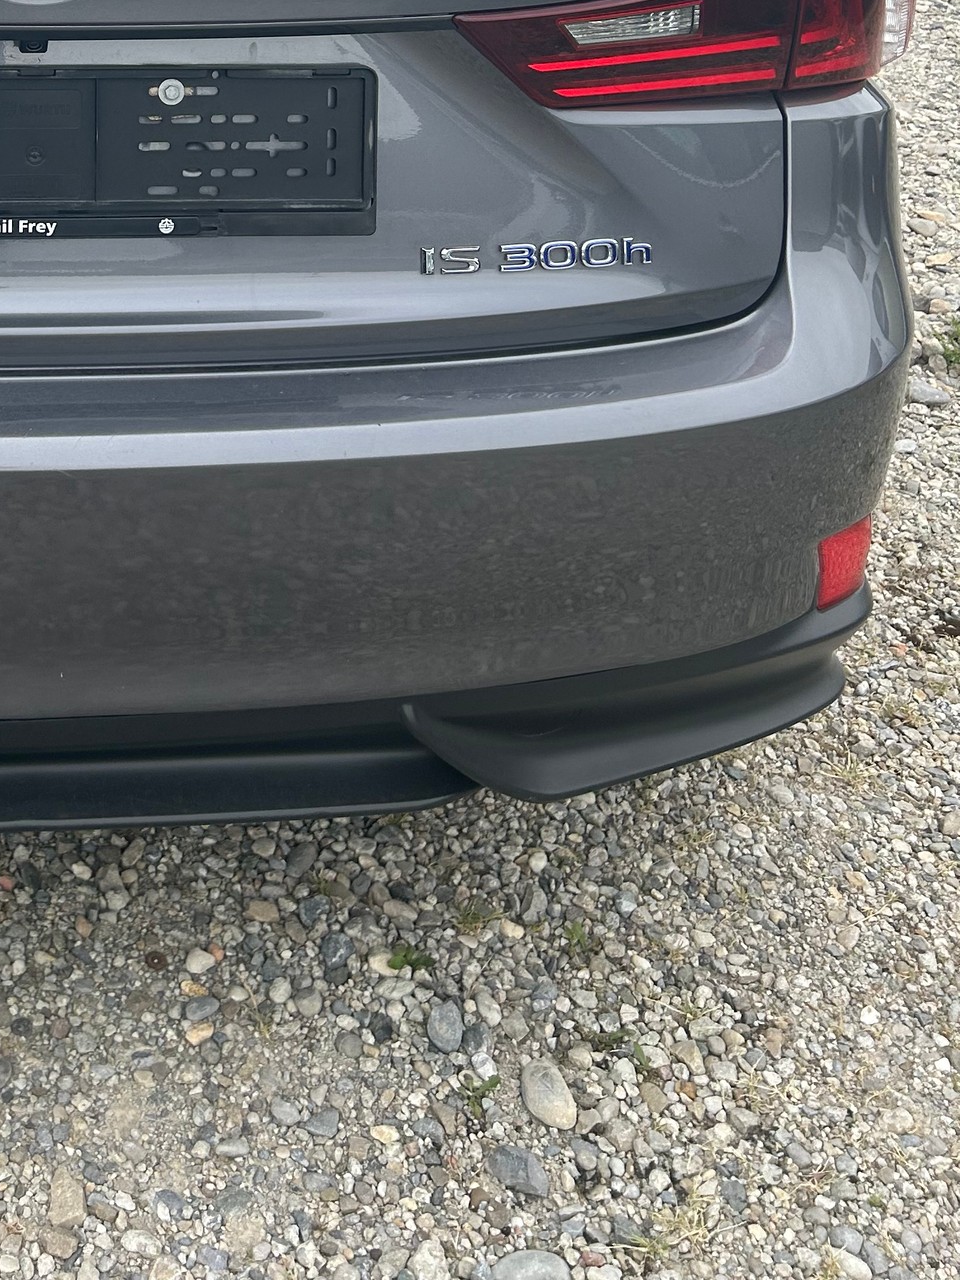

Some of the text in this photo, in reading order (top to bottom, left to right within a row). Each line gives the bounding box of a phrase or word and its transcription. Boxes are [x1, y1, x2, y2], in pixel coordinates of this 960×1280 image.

[18, 220, 58, 236] Frey
[420, 237, 652, 275] IS 300h
